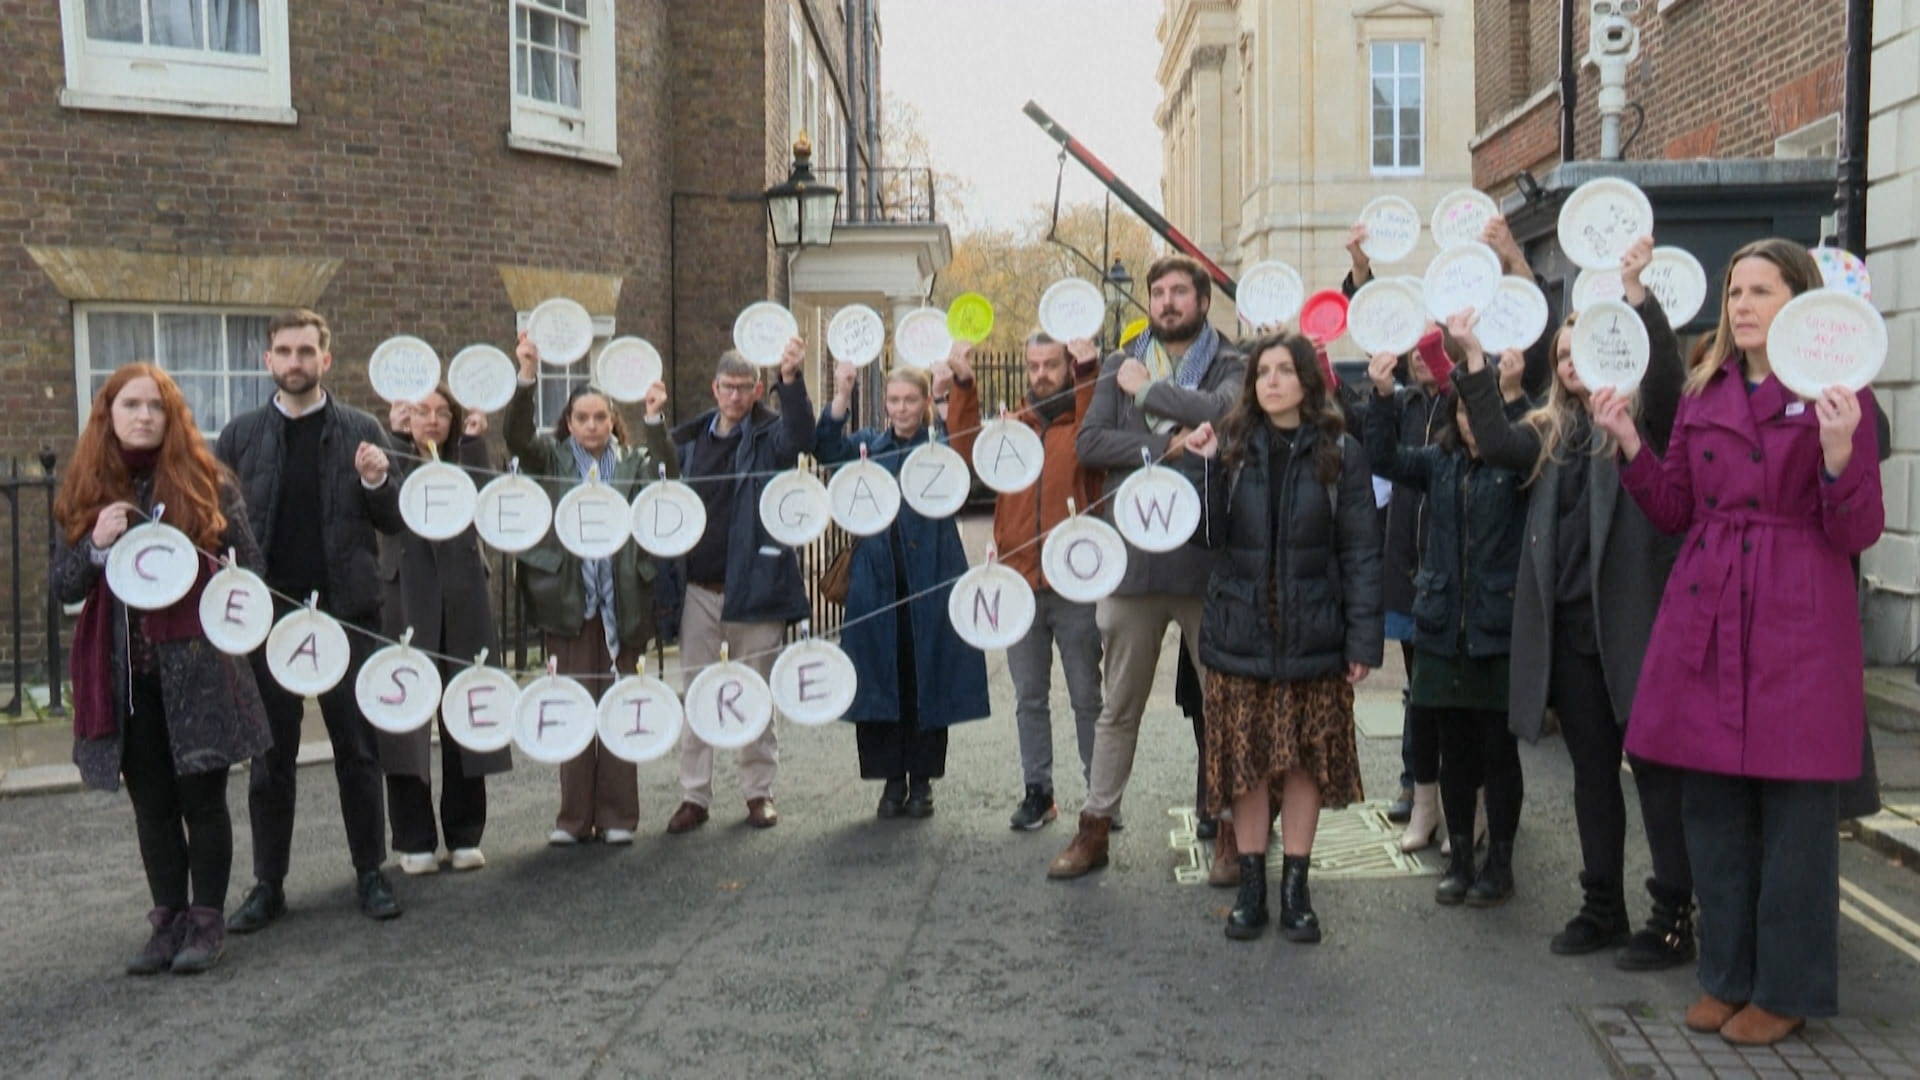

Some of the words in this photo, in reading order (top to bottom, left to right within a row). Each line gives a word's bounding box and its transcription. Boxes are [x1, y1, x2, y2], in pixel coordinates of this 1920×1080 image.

[424, 484, 684, 544] FEED
[778, 434, 1027, 529] GAZA
[134, 544, 828, 743] CEASEFIRE
[972, 488, 1179, 633] NOW
